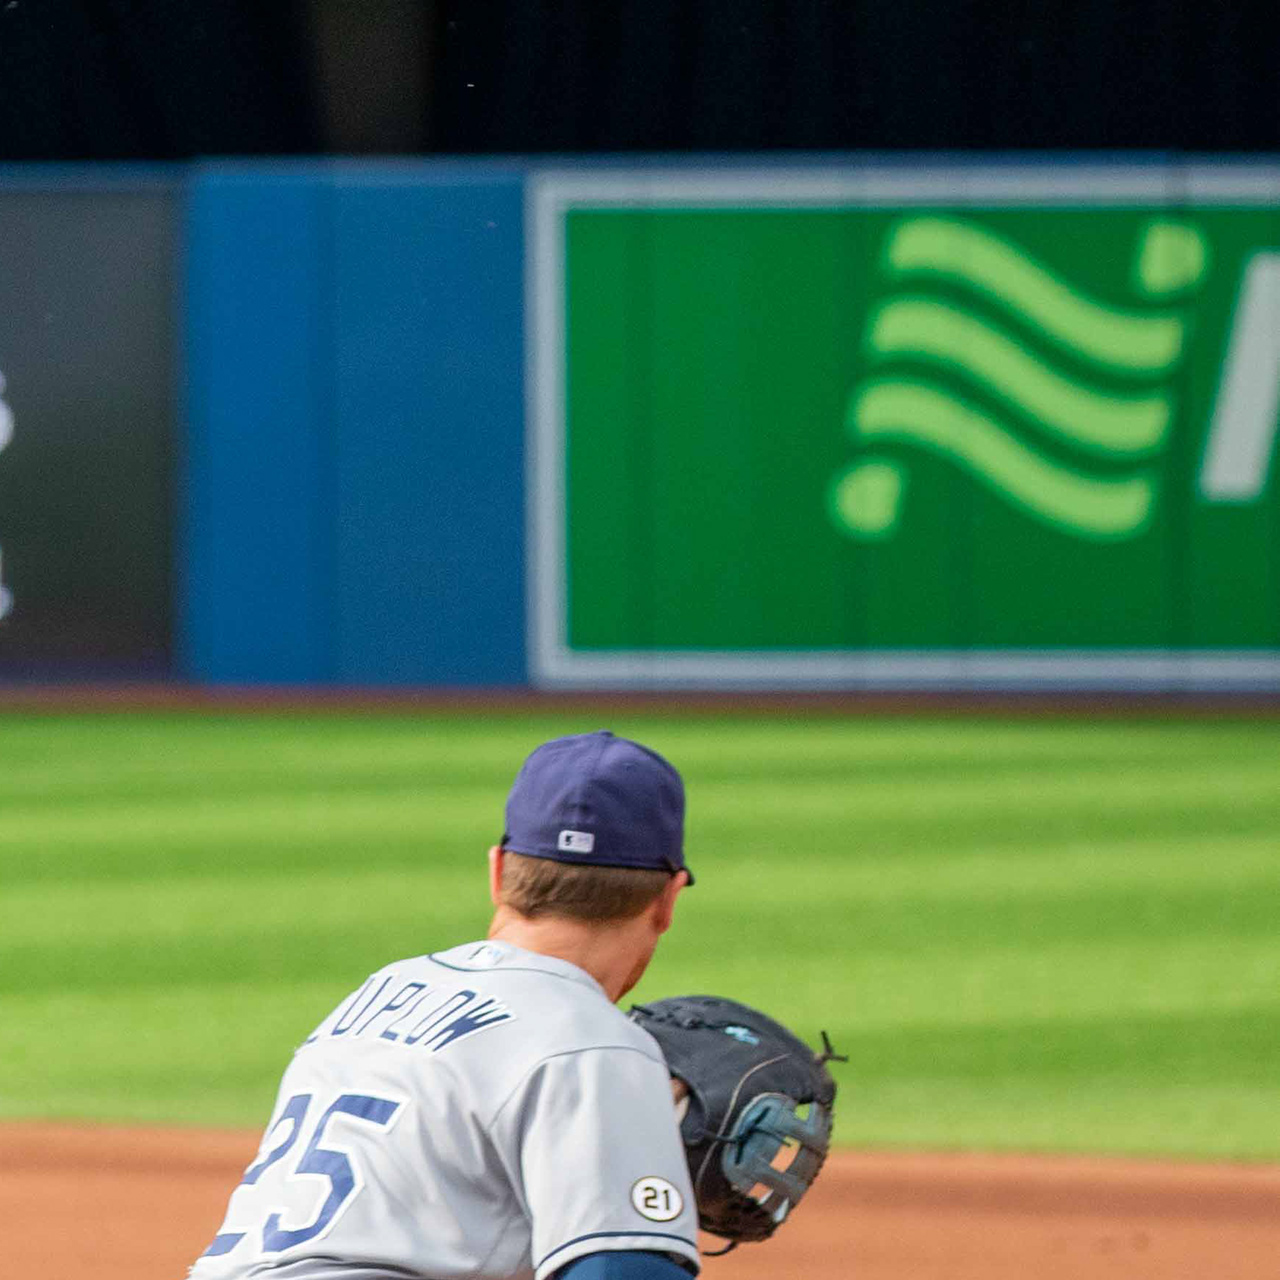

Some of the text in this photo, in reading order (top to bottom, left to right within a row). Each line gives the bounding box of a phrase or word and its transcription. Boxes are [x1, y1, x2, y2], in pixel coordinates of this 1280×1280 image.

[306, 975, 511, 1052] UPLOW
[204, 1093, 400, 1257] 25
[644, 1186, 671, 1211] 21
